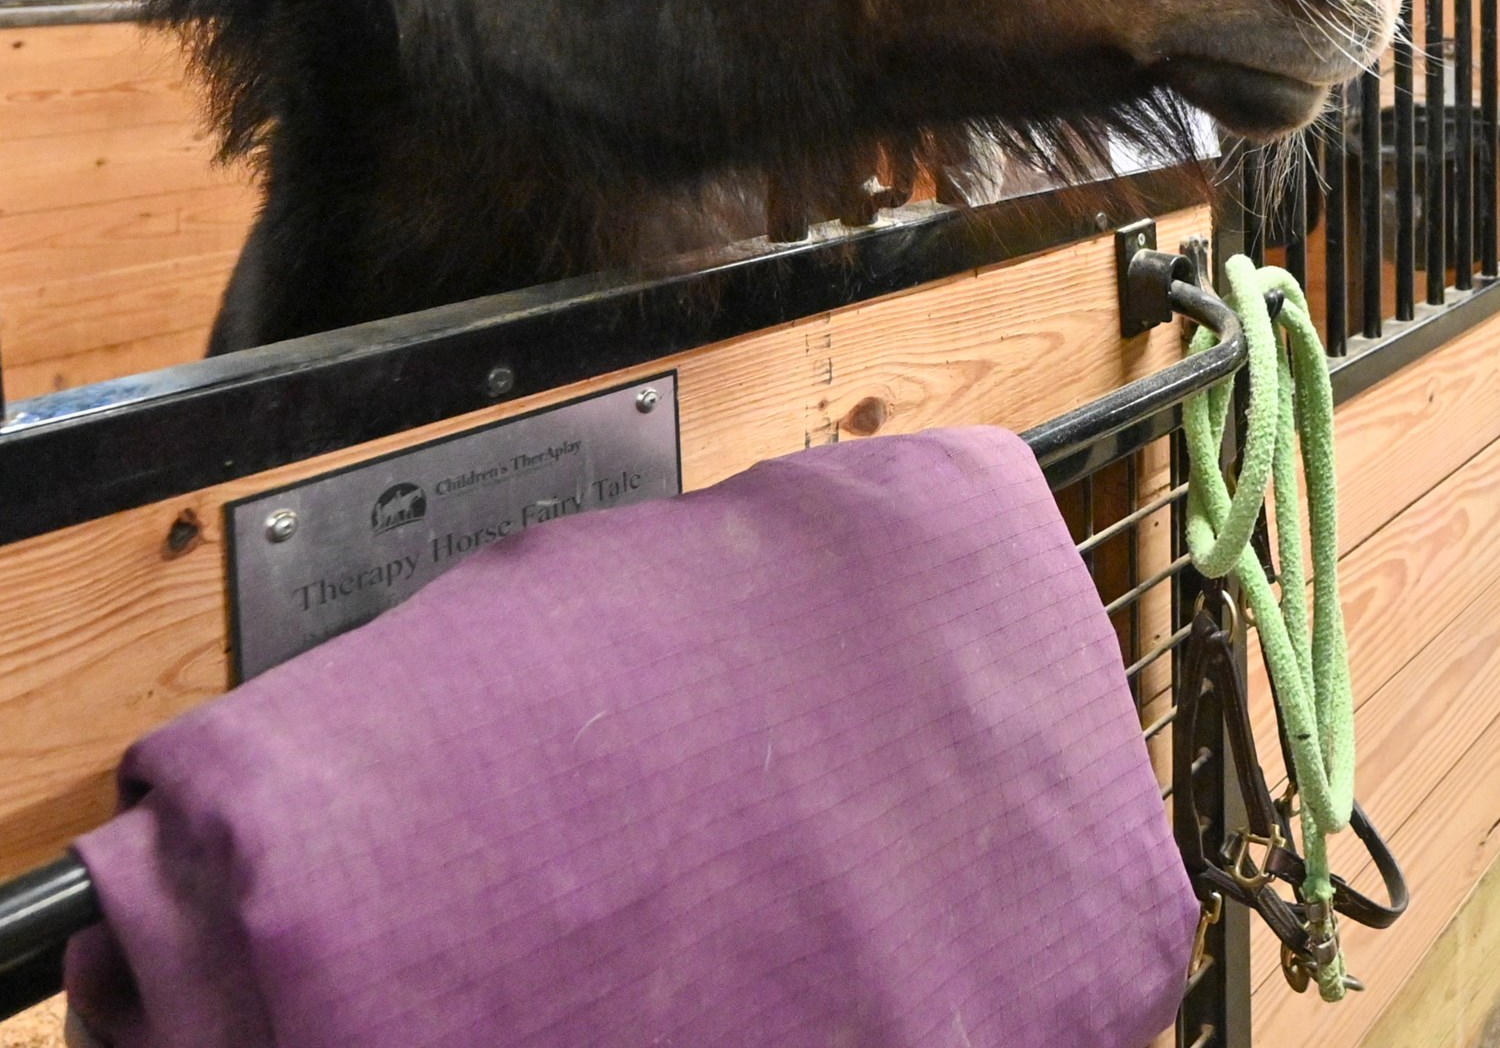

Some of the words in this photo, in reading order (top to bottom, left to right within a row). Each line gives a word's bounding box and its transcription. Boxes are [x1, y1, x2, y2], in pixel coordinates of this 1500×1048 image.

[290, 552, 420, 612] Therapy
[430, 518, 512, 564] Horse
[521, 494, 585, 529] Fairy
[591, 470, 642, 502] Tale
